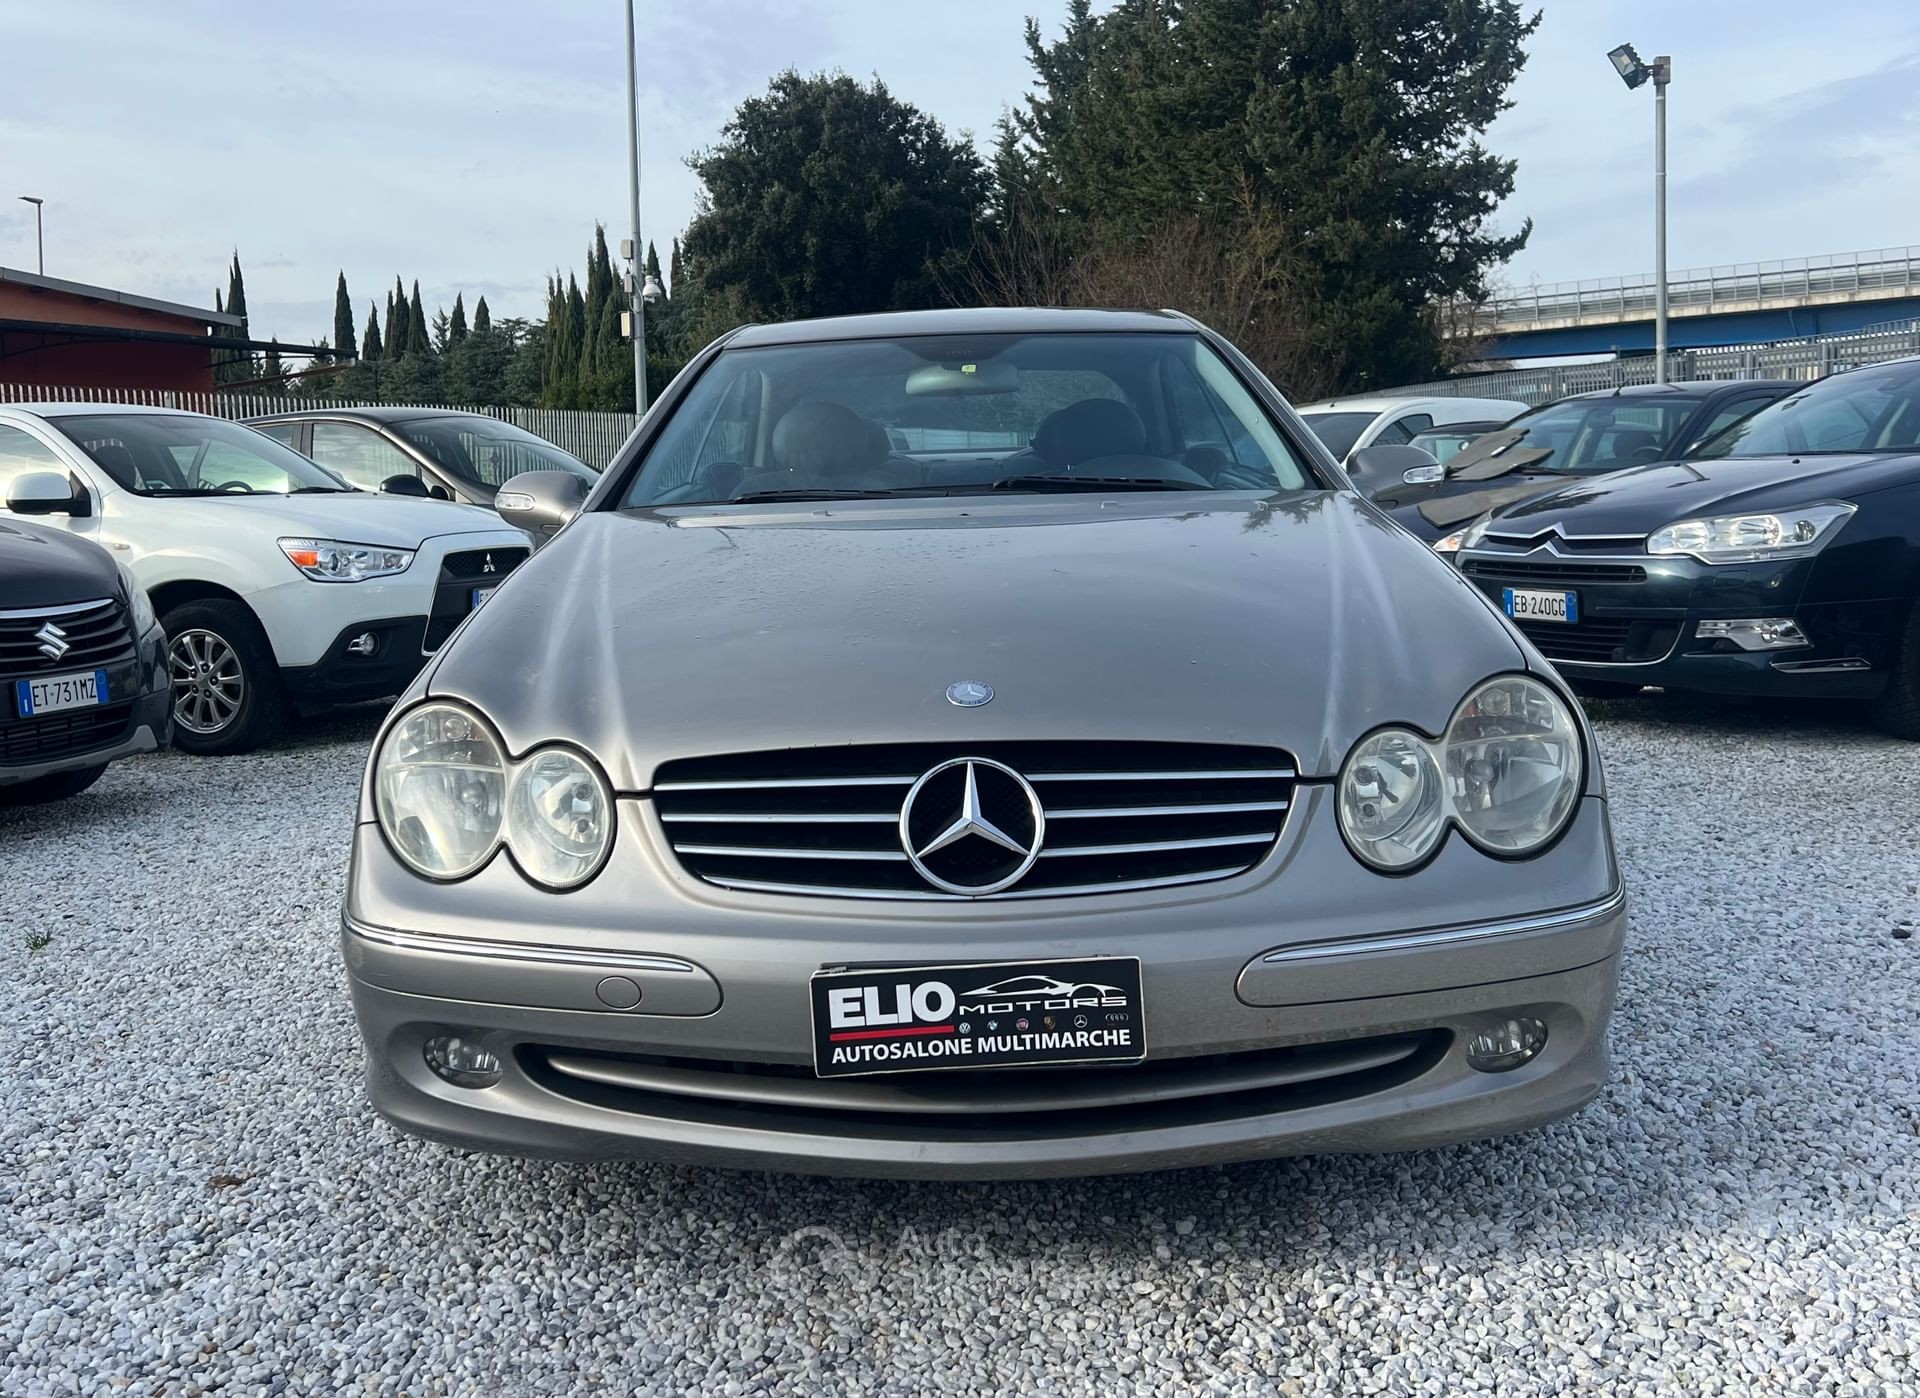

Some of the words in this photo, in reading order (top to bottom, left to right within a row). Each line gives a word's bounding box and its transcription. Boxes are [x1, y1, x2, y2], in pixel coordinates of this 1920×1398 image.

[828, 981, 956, 1029] ELIO
[959, 995, 1127, 1015] MOTORS
[831, 1038, 972, 1064] AUTOSALONE
[977, 1029, 1131, 1054] MULTIMARCHE
